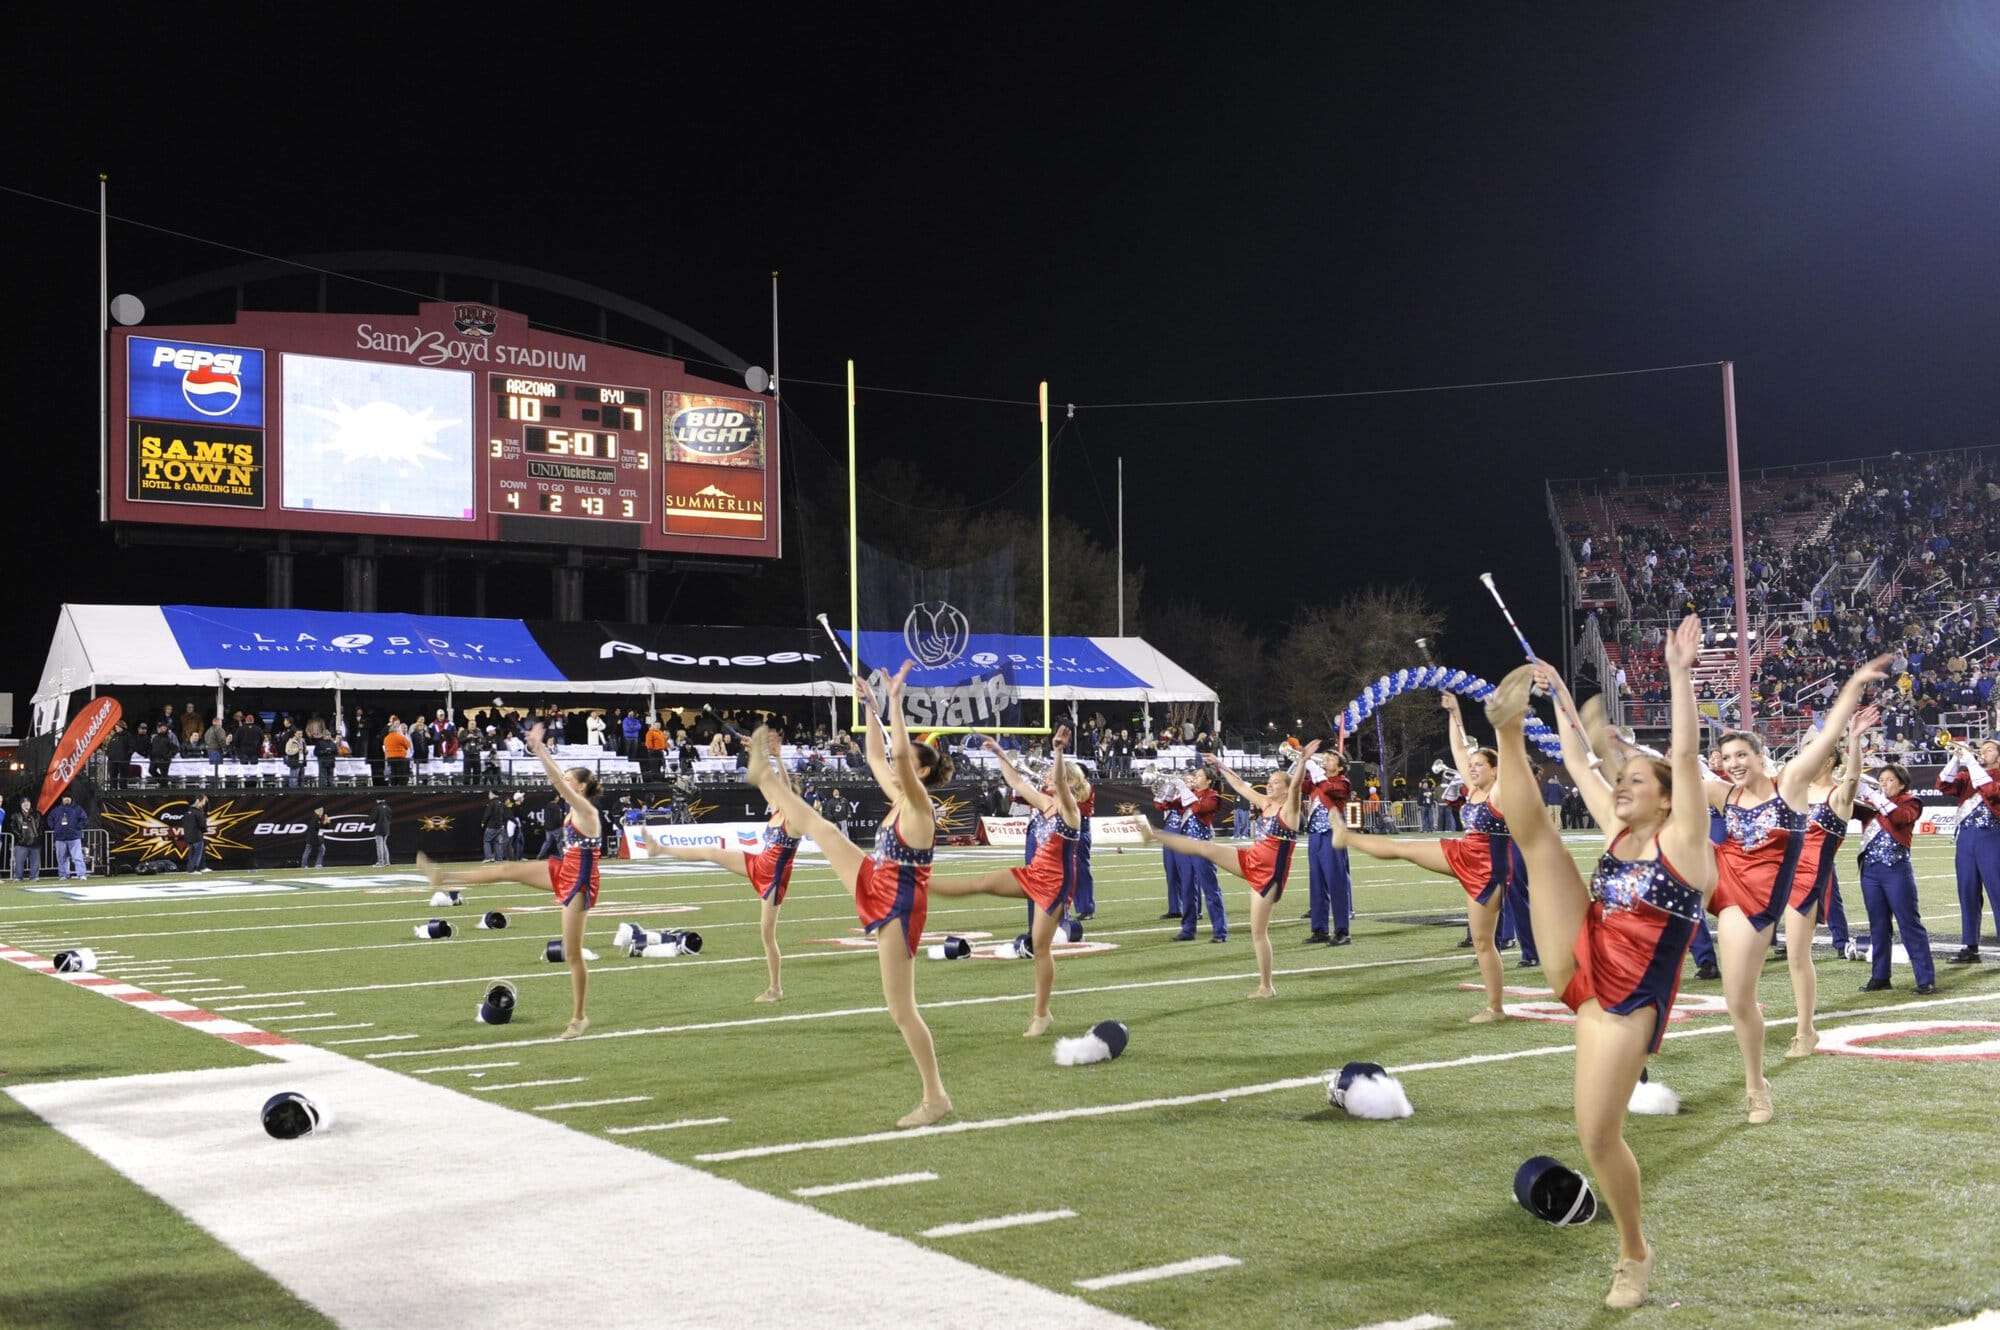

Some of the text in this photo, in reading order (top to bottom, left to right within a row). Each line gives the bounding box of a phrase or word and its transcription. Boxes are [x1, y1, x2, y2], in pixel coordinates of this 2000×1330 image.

[356, 323, 587, 372] Sam Boyd STADIUM
[152, 346, 243, 375] PEPSI
[506, 379, 556, 397] ARIZONA
[600, 388, 625, 404] BYU
[509, 396, 541, 422] 10
[622, 407, 643, 431] 7
[686, 412, 744, 428] BUD
[504, 438, 520, 446] TIME
[677, 428, 751, 442] LIGHT
[142, 436, 253, 465] SAM'S
[490, 440, 502, 457] 3
[548, 430, 616, 459] 5:01
[638, 452, 649, 470] 3
[142, 459, 254, 486] TOWN
[530, 462, 614, 482] UNLVtickets.com
[142, 480, 253, 495] HOTEL & GAMBLING HALL
[500, 480, 527, 490] DOWN
[537, 483, 565, 493] TO GO
[575, 485, 611, 496] BALL ON
[507, 491, 519, 510] 4
[550, 494, 562, 512] 2
[581, 497, 603, 515] 43
[622, 499, 633, 517] 3
[666, 494, 763, 512] SUMMERLIN
[222, 643, 514, 664] FURNITURE GALLERIES
[600, 640, 821, 666] Pioneer
[52, 700, 112, 783] Budweiser
[253, 823, 308, 835] BUD
[659, 834, 721, 847] Chevron
